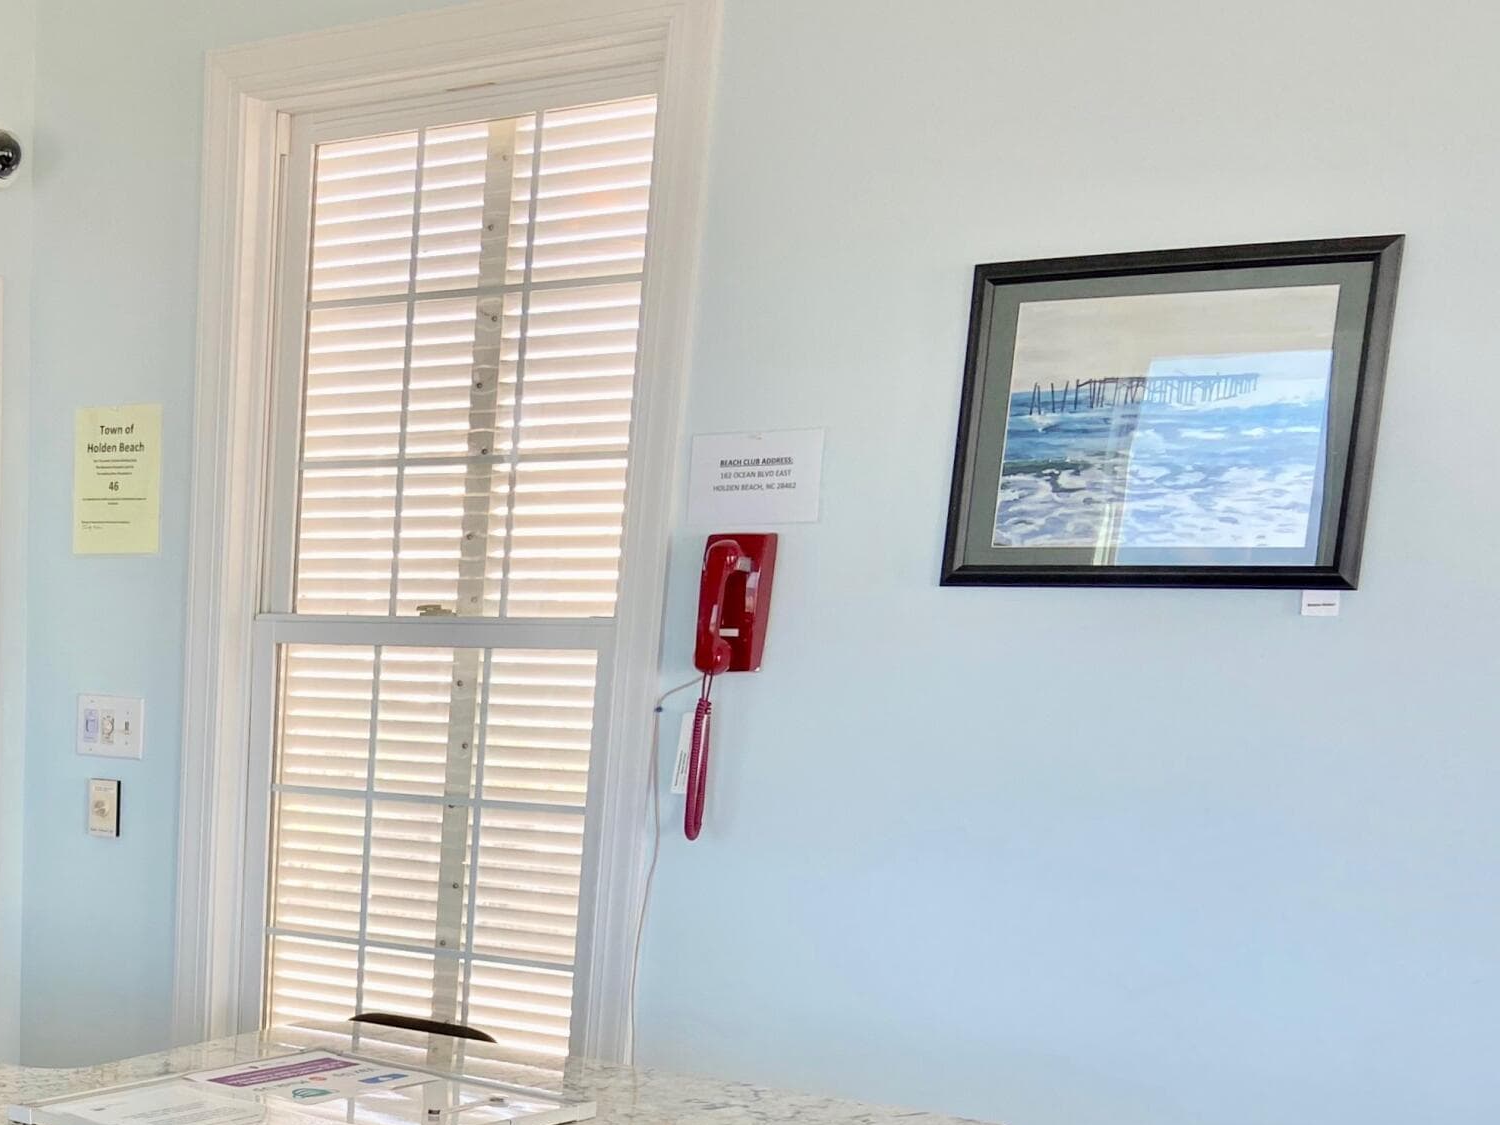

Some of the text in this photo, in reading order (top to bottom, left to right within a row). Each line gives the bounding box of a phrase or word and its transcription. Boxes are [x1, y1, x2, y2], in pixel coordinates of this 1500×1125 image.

[100, 423, 134, 435] Town of
[87, 441, 145, 453] Holden Beach
[720, 459, 741, 467] BEACH
[743, 458, 760, 466] CLUB
[775, 469, 791, 477] EAST
